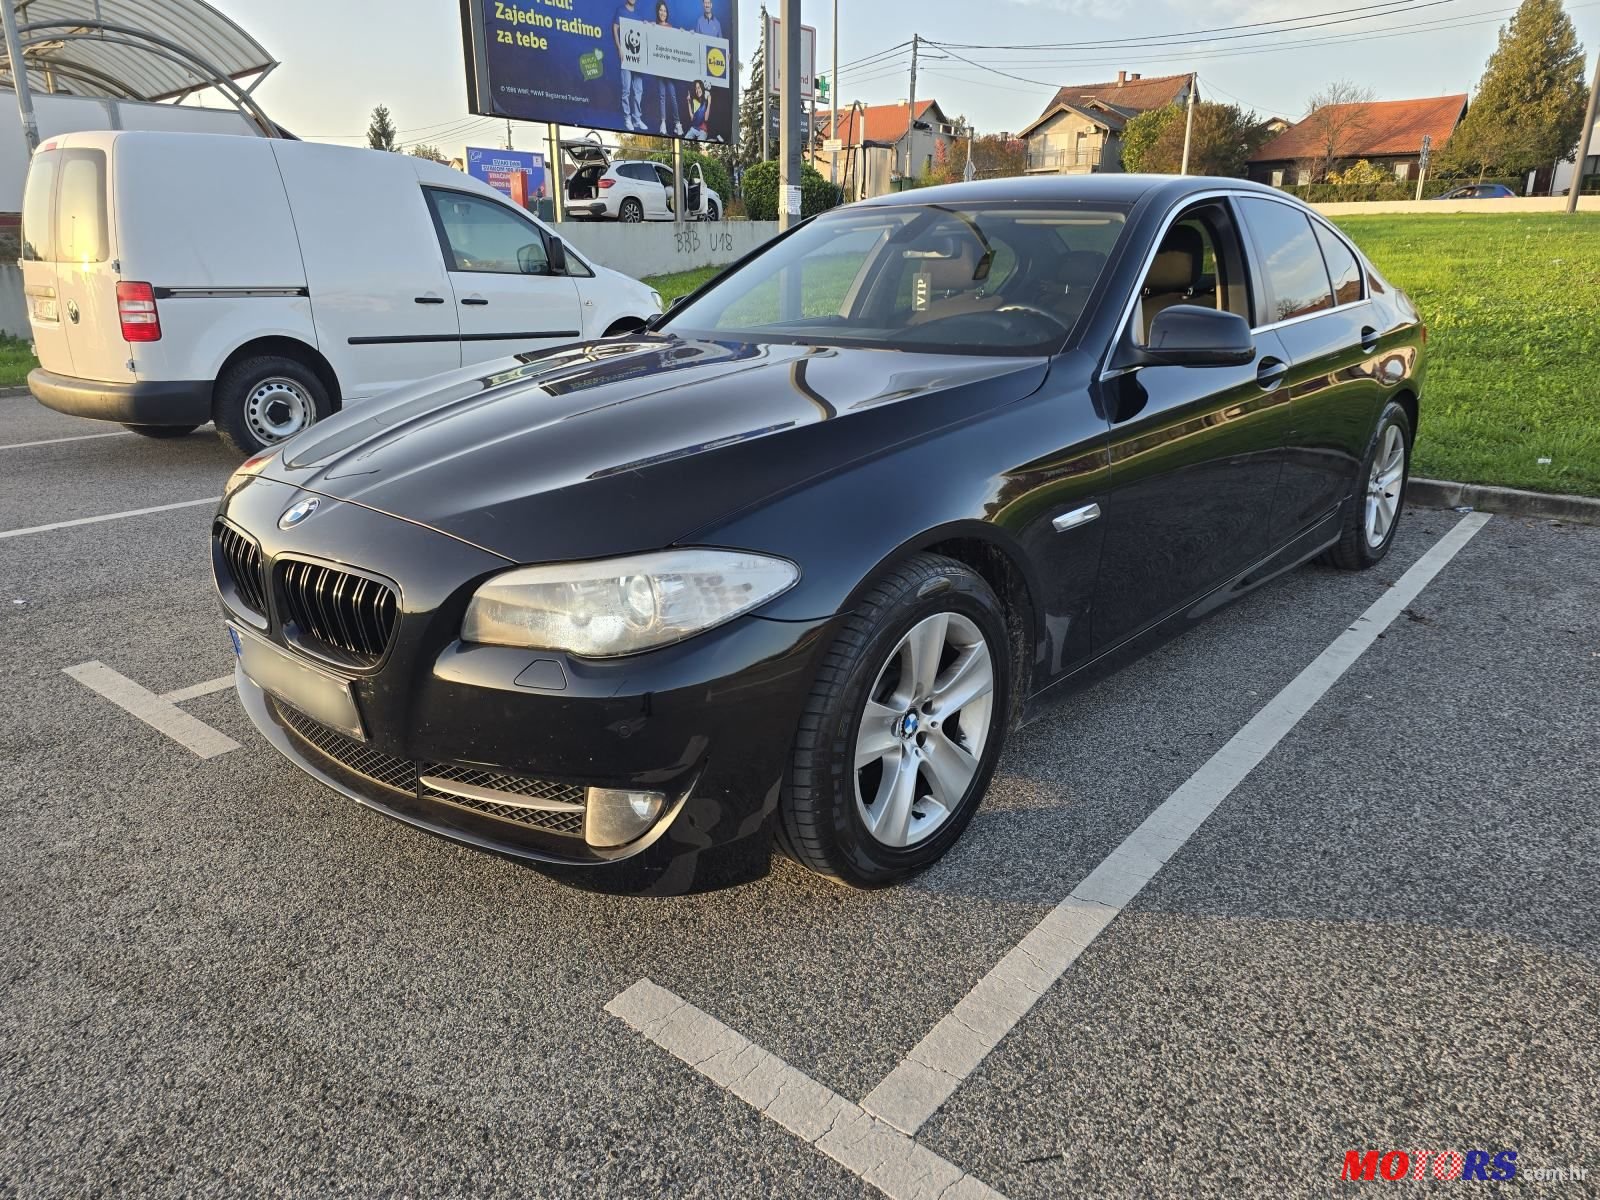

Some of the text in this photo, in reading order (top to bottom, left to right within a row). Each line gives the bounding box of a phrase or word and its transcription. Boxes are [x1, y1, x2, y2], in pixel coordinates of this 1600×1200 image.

[495, 2, 602, 38] Zajedno radimo
[496, 30, 548, 50] za tebe
[625, 54, 641, 65] WWF
[917, 279, 927, 306] VIP
